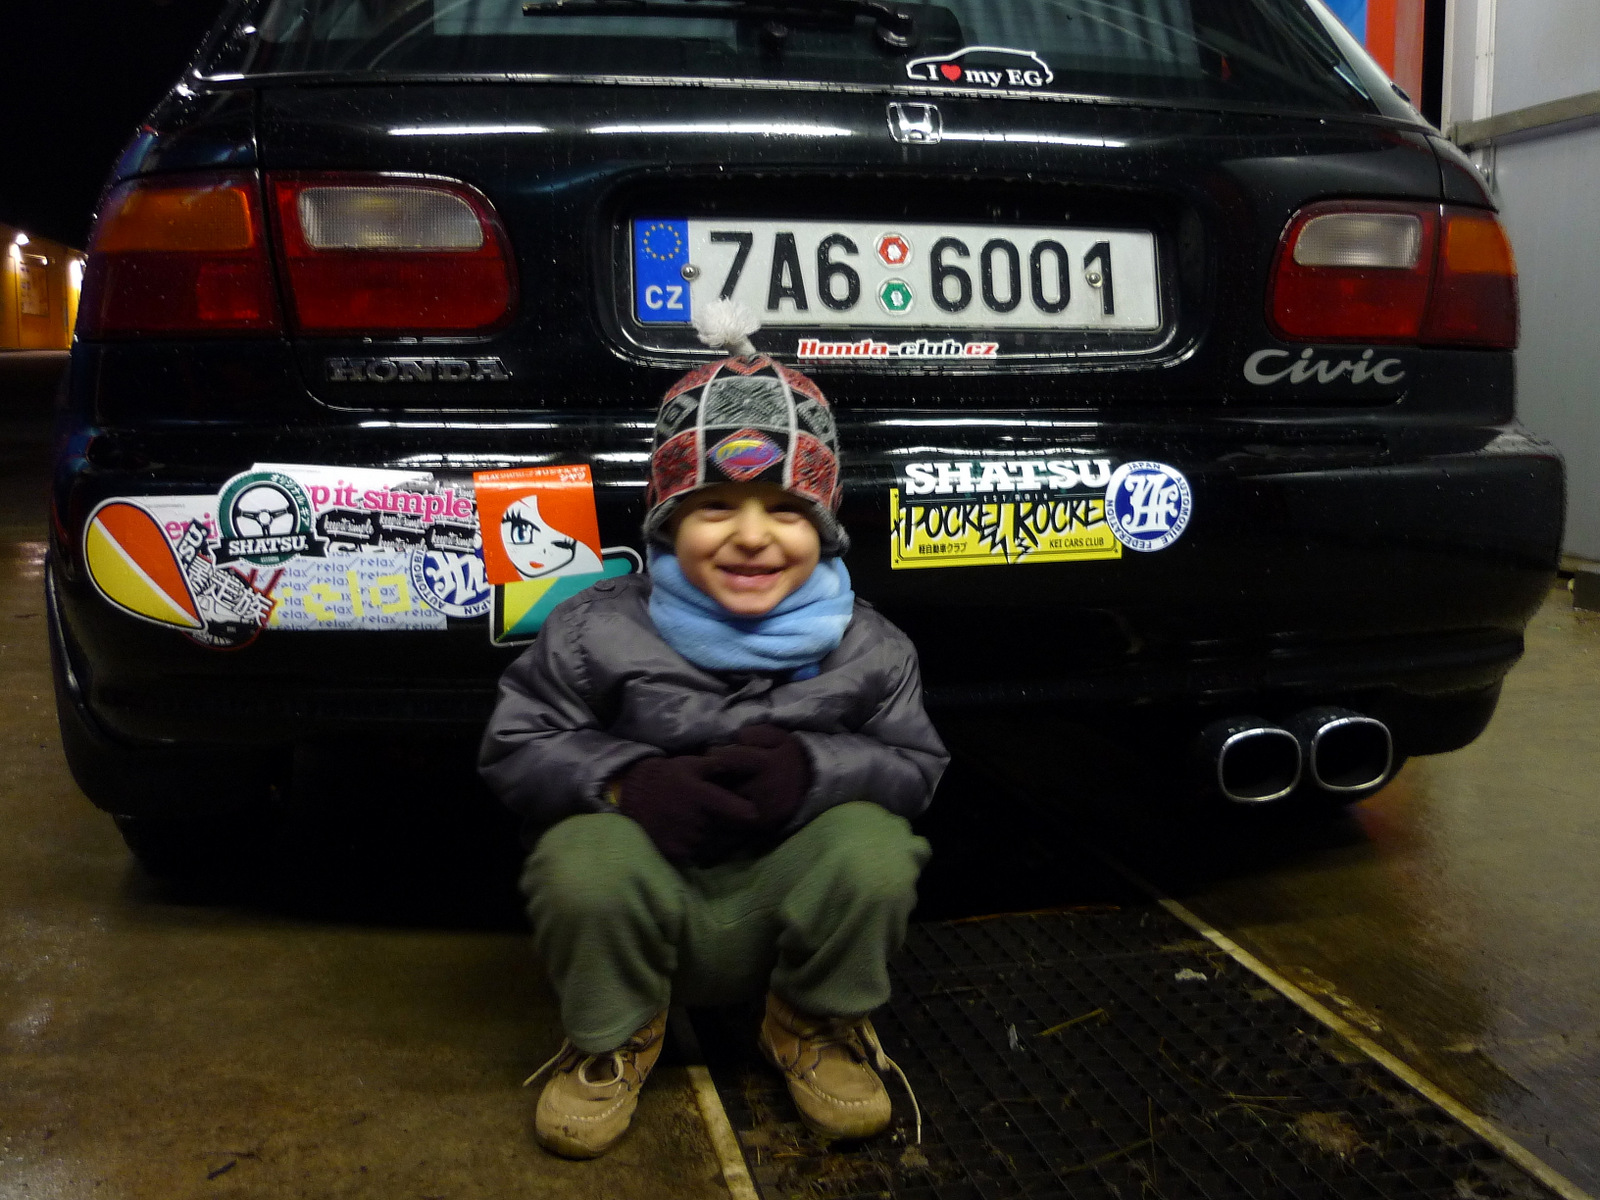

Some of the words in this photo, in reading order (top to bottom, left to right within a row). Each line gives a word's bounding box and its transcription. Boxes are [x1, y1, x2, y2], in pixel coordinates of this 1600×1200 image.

[926, 64, 939, 81] I
[964, 69, 1002, 87] my
[1006, 69, 1043, 87] EG
[709, 230, 861, 312] 7A6
[930, 235, 1116, 316] 6001
[645, 284, 684, 310] CZ
[327, 356, 510, 382] HONDA
[1243, 347, 1406, 386] Civic
[904, 457, 1111, 496] SHATSU
[1128, 461, 1161, 471] JAPAN
[363, 483, 472, 523] simple
[1162, 475, 1191, 545] AUTOMOBILE
[1013, 497, 1106, 549] ROCKE
[1048, 539, 1063, 549] KEI
[1064, 537, 1084, 548] CARS
[1085, 536, 1105, 547] CLUB
[1106, 499, 1152, 549] FEDERATION
[316, 562, 351, 573] relax
